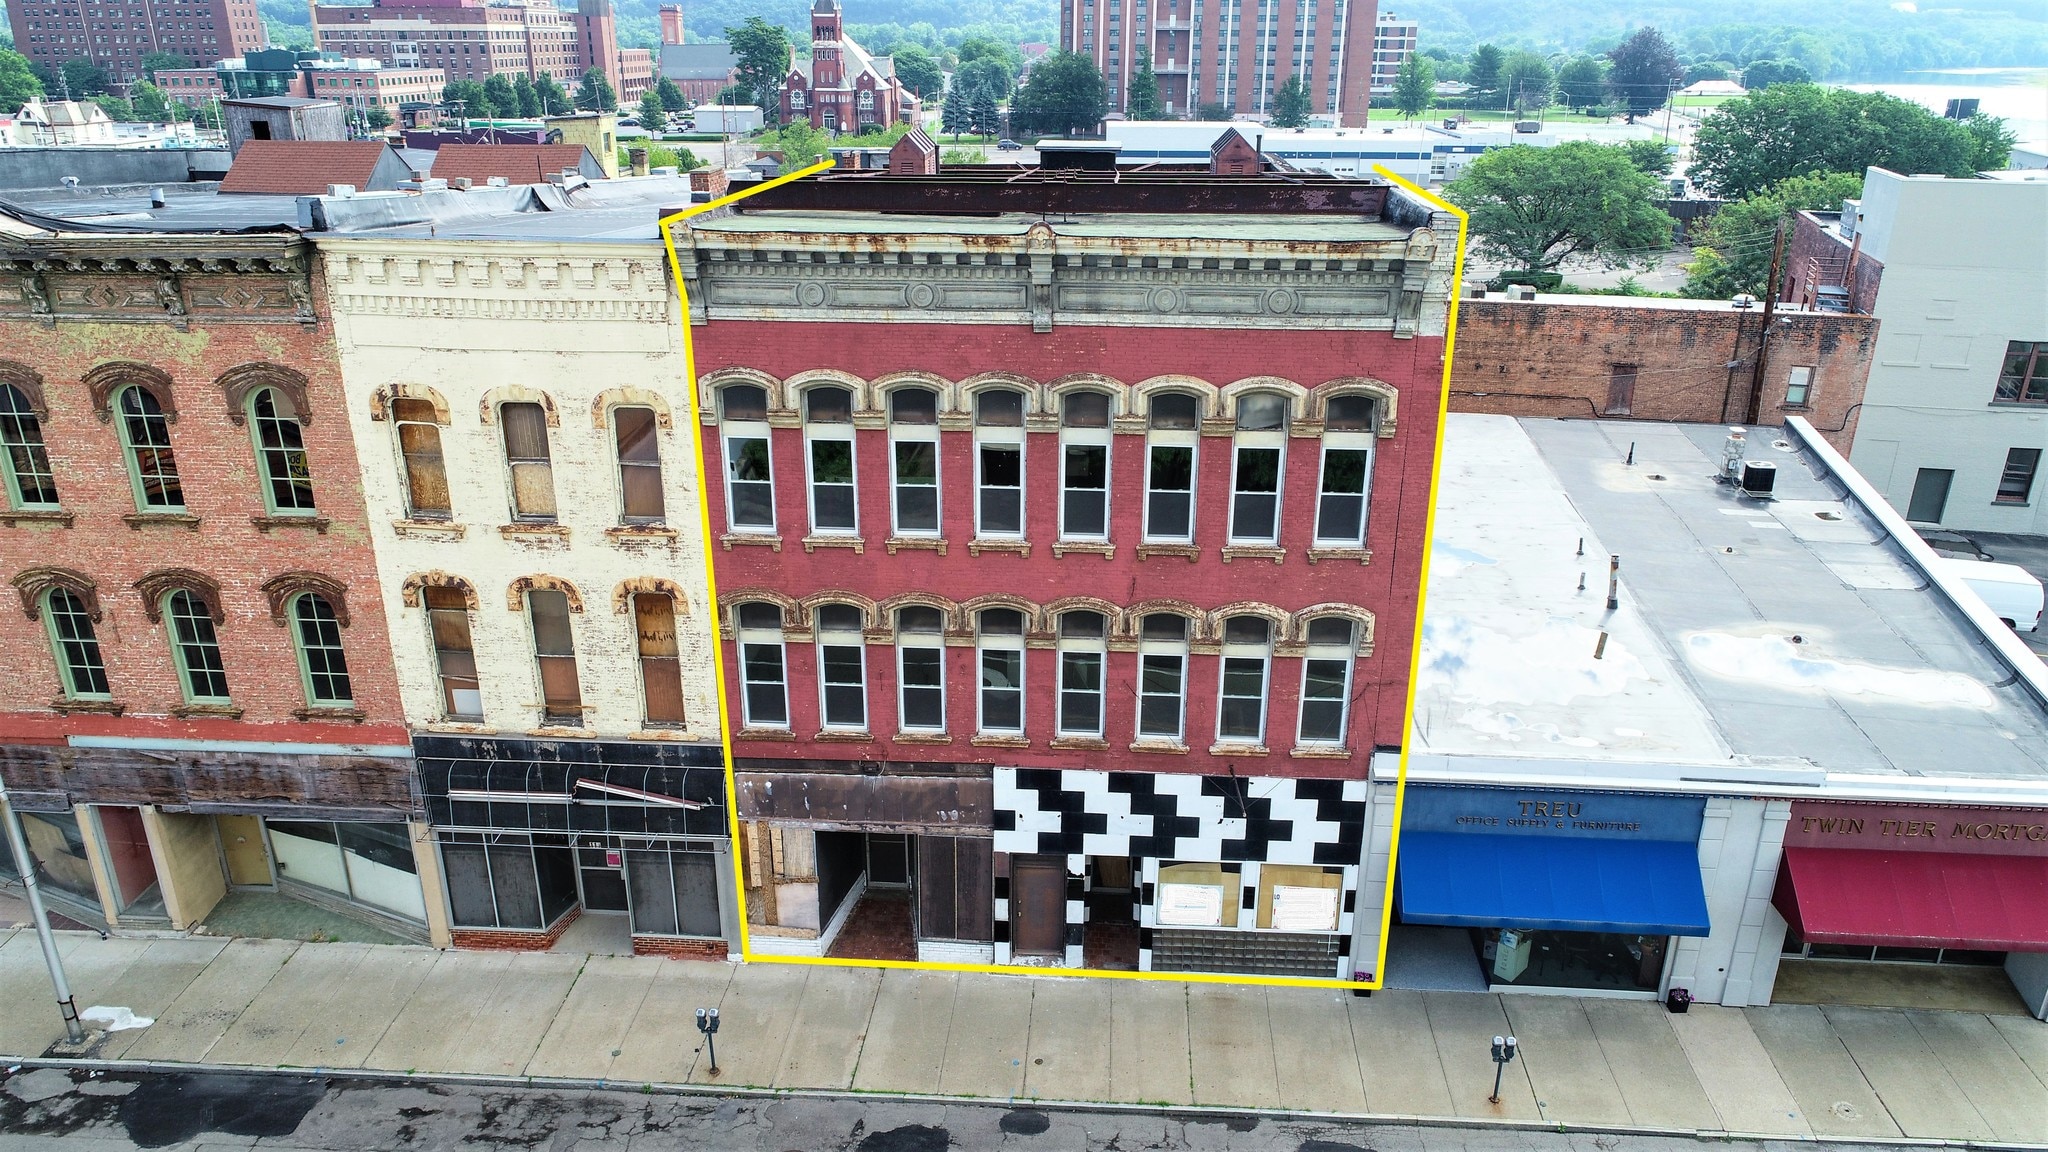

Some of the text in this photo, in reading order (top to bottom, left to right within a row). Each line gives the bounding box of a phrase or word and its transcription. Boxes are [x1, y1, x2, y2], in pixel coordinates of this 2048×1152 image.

[1518, 800, 1583, 817] TREU
[1456, 816, 1641, 831] OFFICE SUPPLY & FURNITURE
[1802, 817, 1865, 834] TWIN
[1880, 819, 1938, 838] TIER
